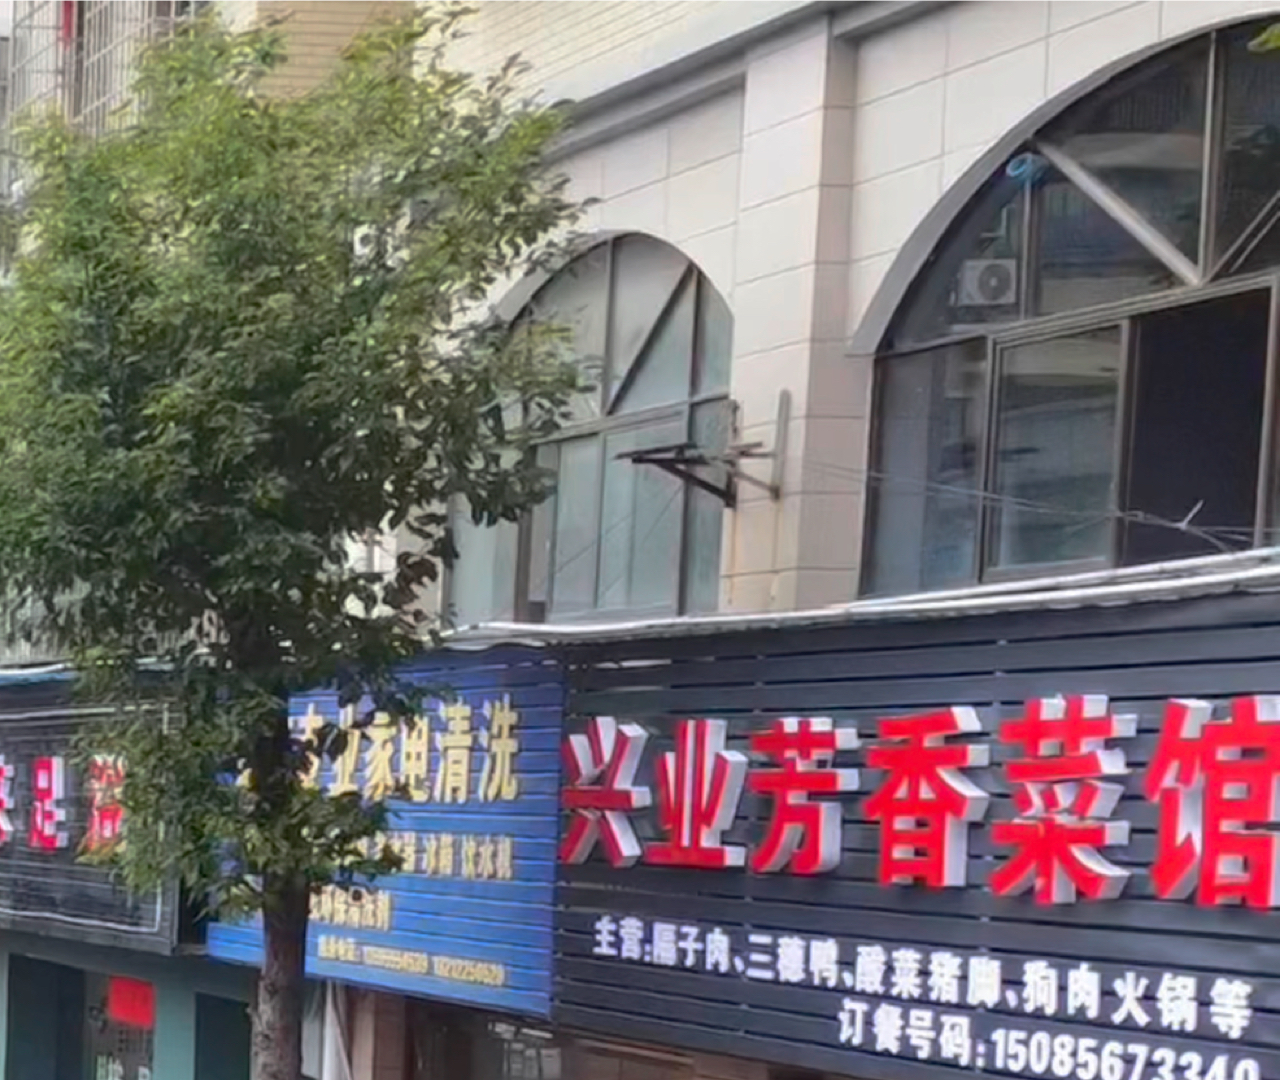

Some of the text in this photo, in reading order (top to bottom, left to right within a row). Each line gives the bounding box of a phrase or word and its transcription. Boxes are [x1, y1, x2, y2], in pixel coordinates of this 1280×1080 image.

[559, 692, 1280, 913] 兴业芳香菜馆
